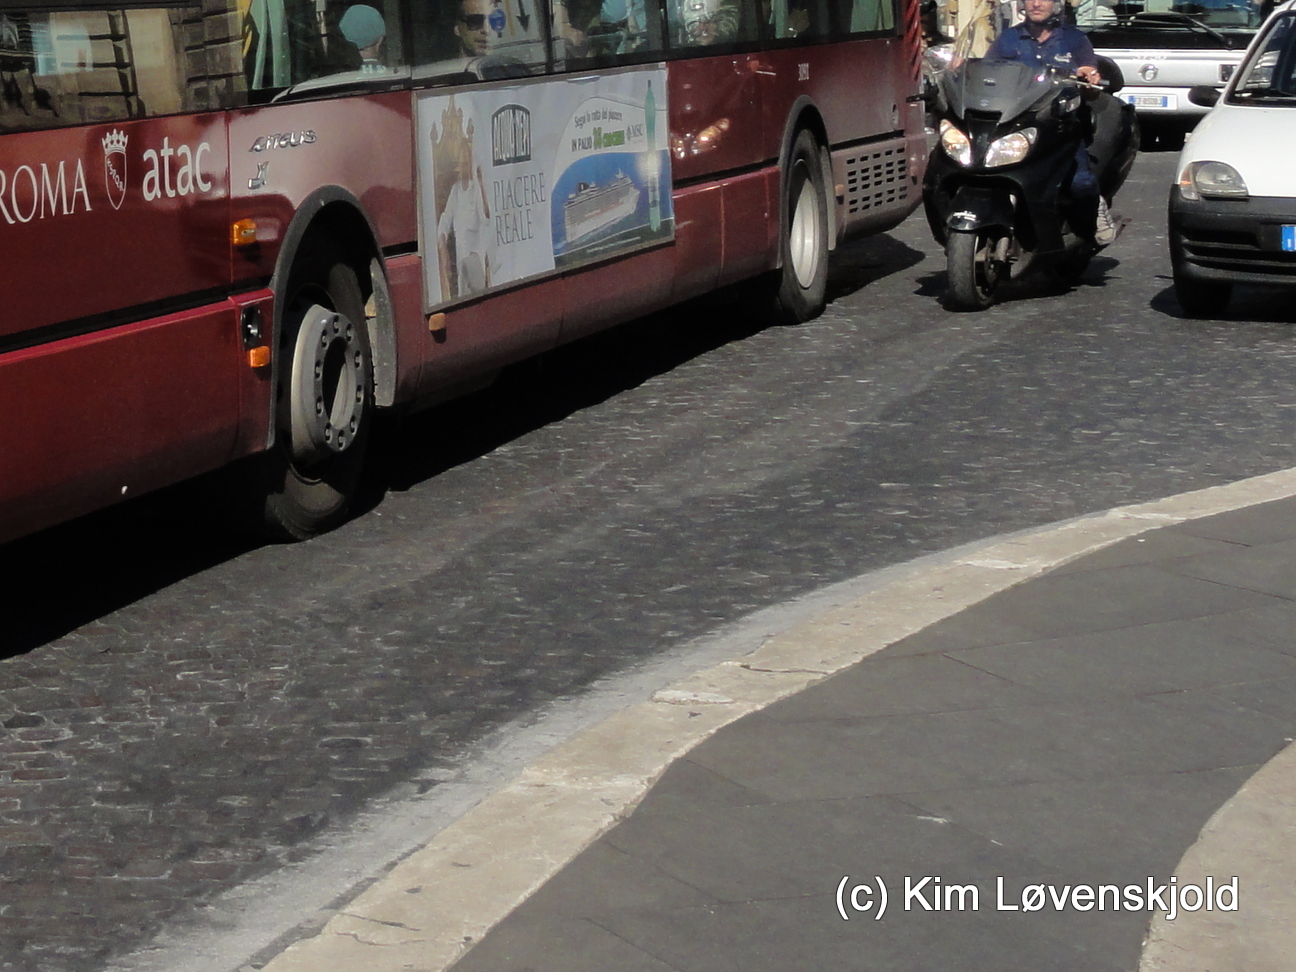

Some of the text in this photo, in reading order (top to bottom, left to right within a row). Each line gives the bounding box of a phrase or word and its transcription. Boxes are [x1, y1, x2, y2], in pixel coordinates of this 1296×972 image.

[142, 136, 212, 202] atac
[492, 172, 546, 212] PIACERE
[495, 208, 534, 247] REALE
